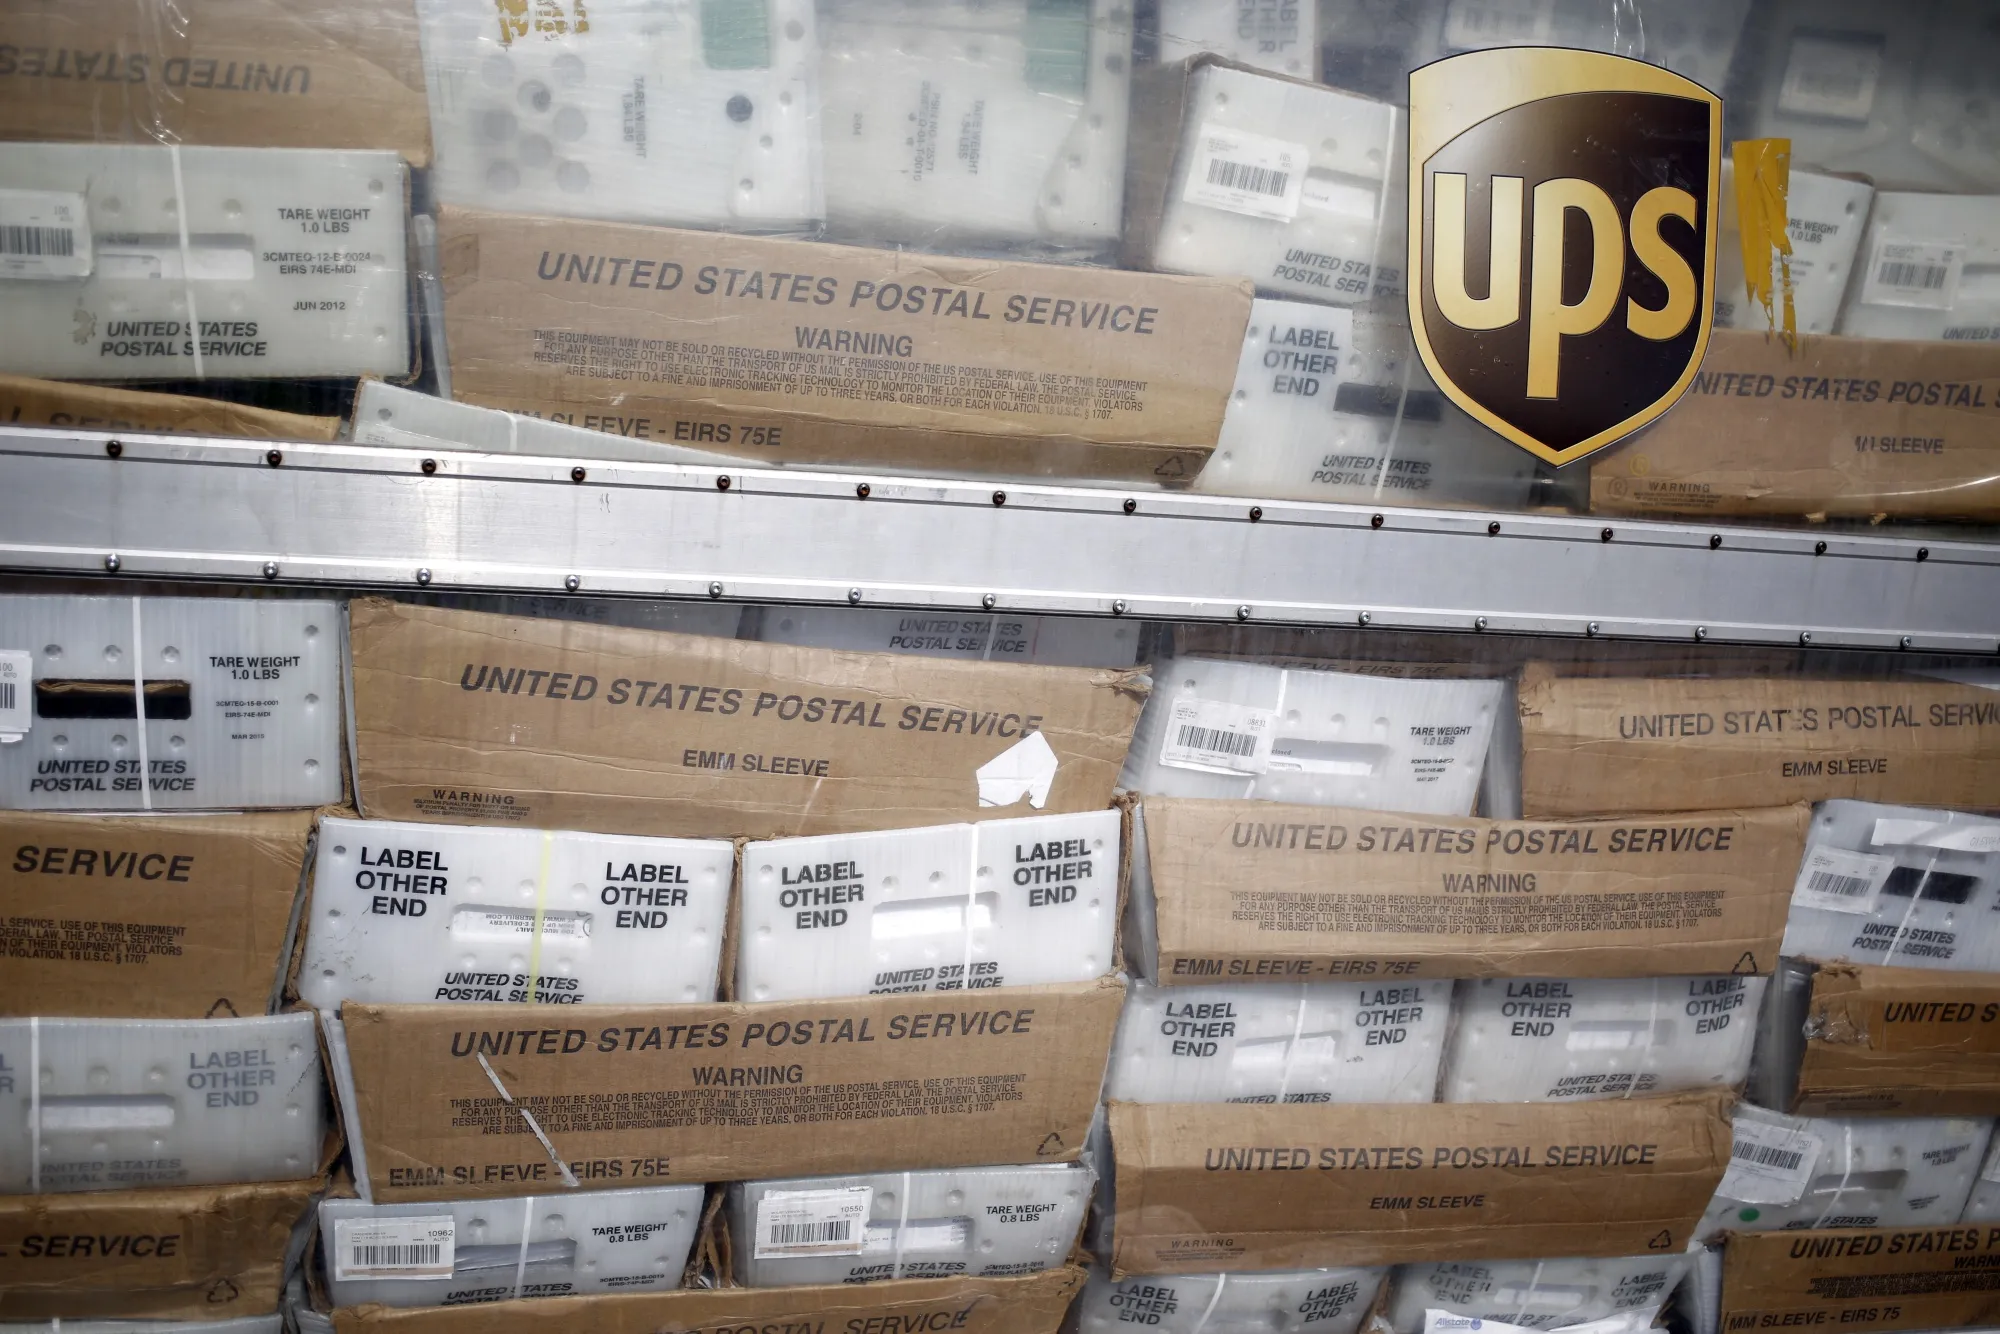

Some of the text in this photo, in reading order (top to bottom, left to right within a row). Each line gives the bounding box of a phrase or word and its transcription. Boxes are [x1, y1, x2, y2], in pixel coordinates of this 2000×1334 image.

[162, 56, 311, 94] UNITED
[278, 208, 371, 220] TARE WEIGHT
[301, 222, 350, 233] 1.0 LBS
[1804, 220, 1840, 235] WEIGHT
[280, 264, 307, 275] EIRS
[1285, 249, 1342, 271] UNITED
[1273, 265, 1331, 288] POSTAL
[538, 251, 1159, 335] UNITED STATES POSTAL SERVICE
[293, 301, 346, 311] JUN 2012
[107, 321, 180, 337] UNITED
[1268, 325, 1340, 350] LABEL
[100, 342, 180, 357] POSTAL
[796, 326, 913, 357] WARNING
[1263, 350, 1339, 375] OTHER
[1272, 376, 1320, 397] END
[1782, 376, 1988, 408] STATES POSTAL
[674, 421, 782, 446] EIRS 75E
[1880, 437, 1944, 455] SLEEVE
[1322, 454, 1375, 470] UNITED
[1648, 480, 1712, 494] WARNING
[900, 619, 959, 635] UNITED
[889, 635, 953, 651] POSTAL
[210, 656, 301, 668] TARE WEIGHT
[231, 669, 281, 680] 1.0 LBS
[460, 663, 886, 728] UNITED STATES POSTAL
[1410, 726, 1472, 736] TARE WEIGHT
[1619, 704, 1921, 740] UNITED POSTAL
[1437, 736, 1455, 746] LBS
[37, 760, 109, 775] UNITED
[683, 749, 830, 777] EMM SLEEVE
[1782, 758, 1887, 778] EMM SLEEVE
[30, 778, 107, 792] POSTAL
[433, 789, 515, 805] WARNING
[1231, 822, 1734, 854] UNITED STATES POSTAL SERVICE
[361, 846, 448, 871] LABEL
[1016, 839, 1091, 863] LABEL
[13, 844, 194, 883] SERVICE
[606, 862, 689, 884] LABEL
[781, 861, 864, 885] LABEL
[1013, 860, 1093, 886] OTHER
[355, 870, 447, 896] OTHER
[1442, 872, 1536, 893] WARNING
[601, 886, 689, 907] OTHER
[779, 883, 864, 909] OTHER
[1028, 884, 1077, 907] END
[372, 896, 427, 917] END
[616, 910, 668, 929] END
[796, 907, 848, 929] END
[1909, 928, 1956, 944] STATES
[874, 967, 935, 986] UNITED
[1173, 958, 1421, 976] EMM SLEEVE EIRS 75E
[445, 972, 510, 987] UNITED
[435, 987, 503, 1003] POSTAL
[1360, 987, 1424, 1006] LABEL
[1507, 983, 1573, 998] LABEL
[1166, 1002, 1237, 1018] LABEL
[1501, 1002, 1572, 1018] OTHER
[1685, 993, 1744, 1016] OTHER
[1884, 1002, 1975, 1024] UNITED
[1355, 1007, 1423, 1027] OTHER
[1695, 1014, 1730, 1034] END
[451, 1009, 1035, 1057] UNITED STATES POSTAL SERVICE
[1161, 1021, 1235, 1037] OTHER
[1365, 1028, 1406, 1046] END
[1511, 1022, 1554, 1037] END
[1171, 1041, 1217, 1057] END
[190, 1050, 275, 1069] LABEL
[187, 1069, 275, 1090] OTHER
[692, 1064, 803, 1087] WARNING
[206, 1090, 259, 1108] END
[451, 1099, 471, 1108] THIS
[531, 1096, 549, 1105] MAY
[552, 1095, 572, 1104] NOT
[574, 1095, 585, 1103] BE
[588, 1094, 613, 1102] SOLD
[616, 1093, 628, 1101] OR
[631, 1091, 679, 1101] RECYCLED
[682, 1089, 721, 1099] WITHOUT
[724, 1088, 741, 1097] THE
[744, 1085, 797, 1096] PERMISSION
[800, 1085, 812, 1093] OF
[814, 1084, 830, 1092] THE
[833, 1083, 845, 1092] US
[847, 1082, 879, 1091] POSTAL
[924, 1079, 940, 1087] USE
[943, 1078, 954, 1086] OF
[957, 1077, 975, 1086] THIS
[978, 1074, 1026, 1085] EQUIPMENT
[1548, 1086, 1597, 1098] POSTAL
[1205, 1144, 1657, 1171] UNITED STATES POSTAL SERVICE
[389, 1157, 670, 1187] EMM SLEEVE EIRS 75E
[841, 1205, 863, 1213] 10550
[986, 1204, 1057, 1215] TARE WEIGHT
[1370, 1195, 1485, 1210] EMM SLEEVE
[1000, 1213, 1040, 1223] 0.8 LBS
[427, 1229, 453, 1237] 10962
[592, 1223, 668, 1236] TARE WEIGHT
[609, 1232, 649, 1243] 0.8 LBS
[20, 1234, 180, 1257] SERVICE
[1171, 1238, 1234, 1249] WARNING
[1790, 1229, 1984, 1259] UNITED STATES
[447, 1286, 507, 1300] UNITED
[1435, 1317, 1470, 1326] Allstate
[1760, 1308, 1877, 1328] SLEEVE EIRS
